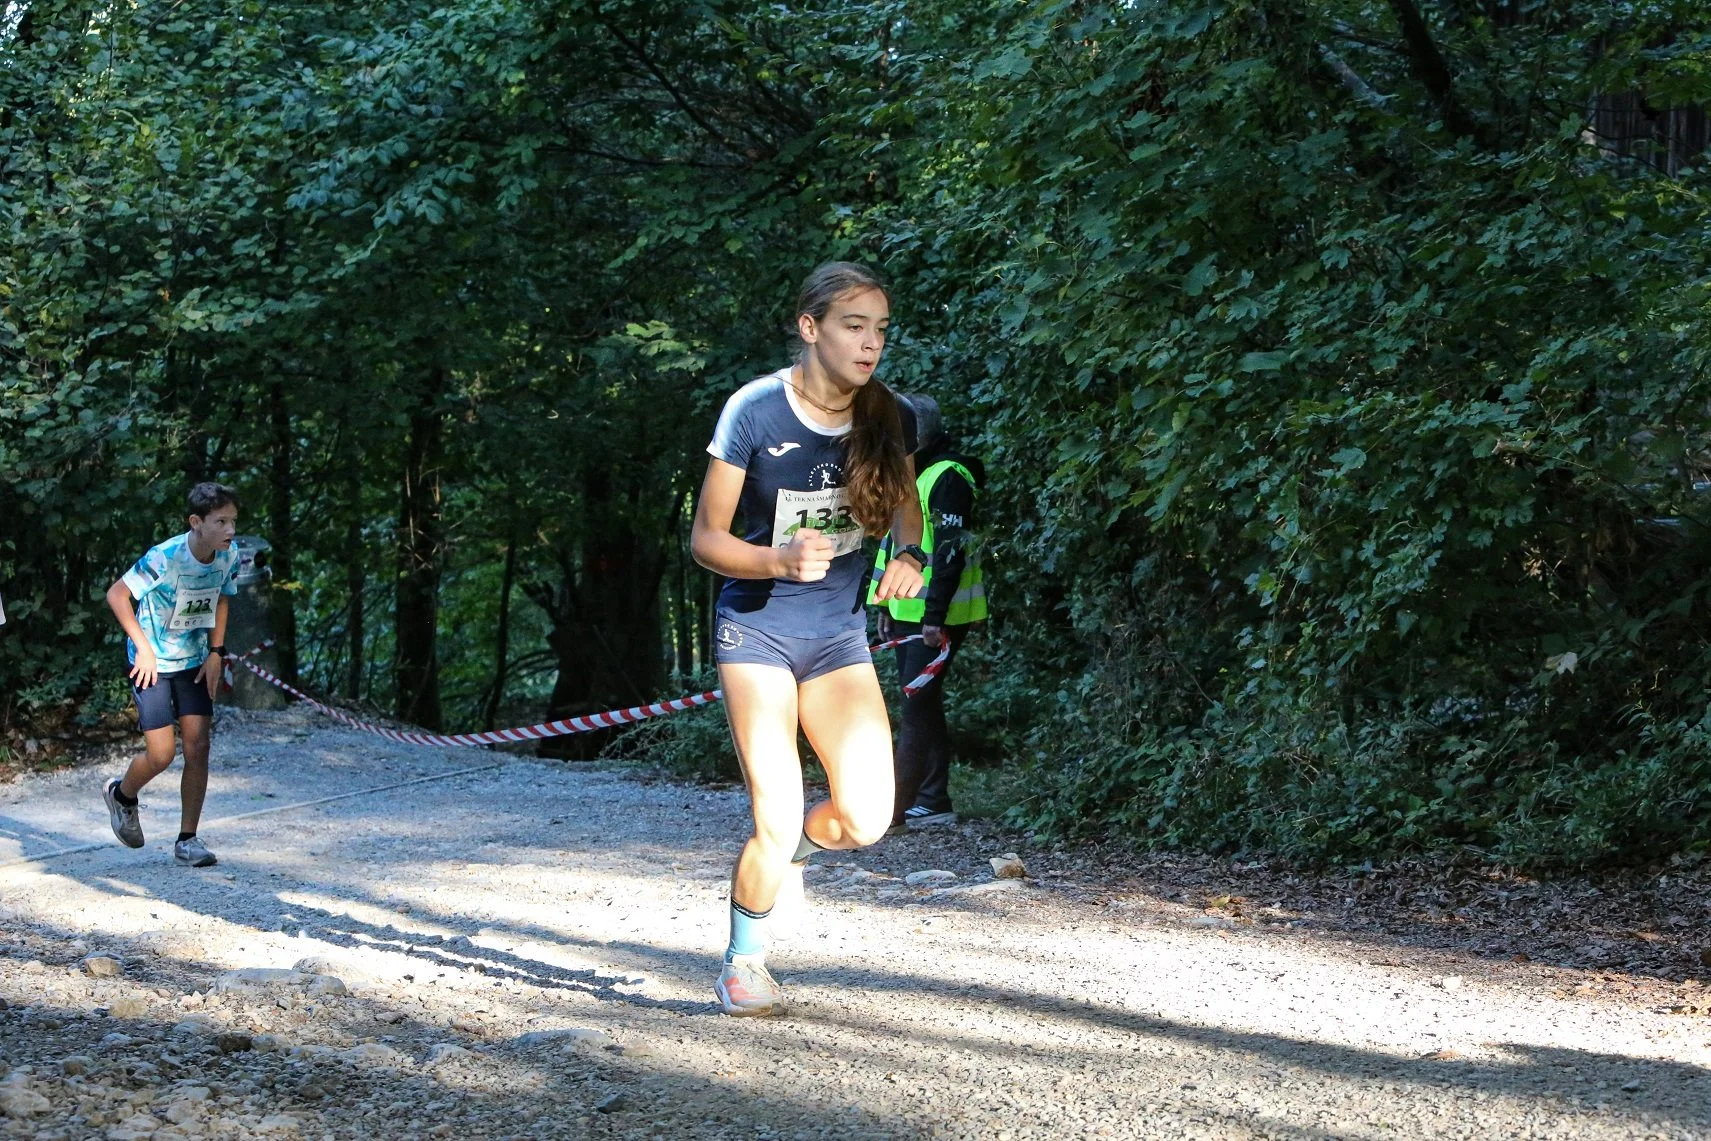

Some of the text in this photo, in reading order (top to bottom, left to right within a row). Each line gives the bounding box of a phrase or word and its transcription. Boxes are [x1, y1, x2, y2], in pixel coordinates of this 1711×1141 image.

[796, 506, 853, 530] 133
[942, 513, 963, 527] HH
[187, 599, 211, 613] 123
